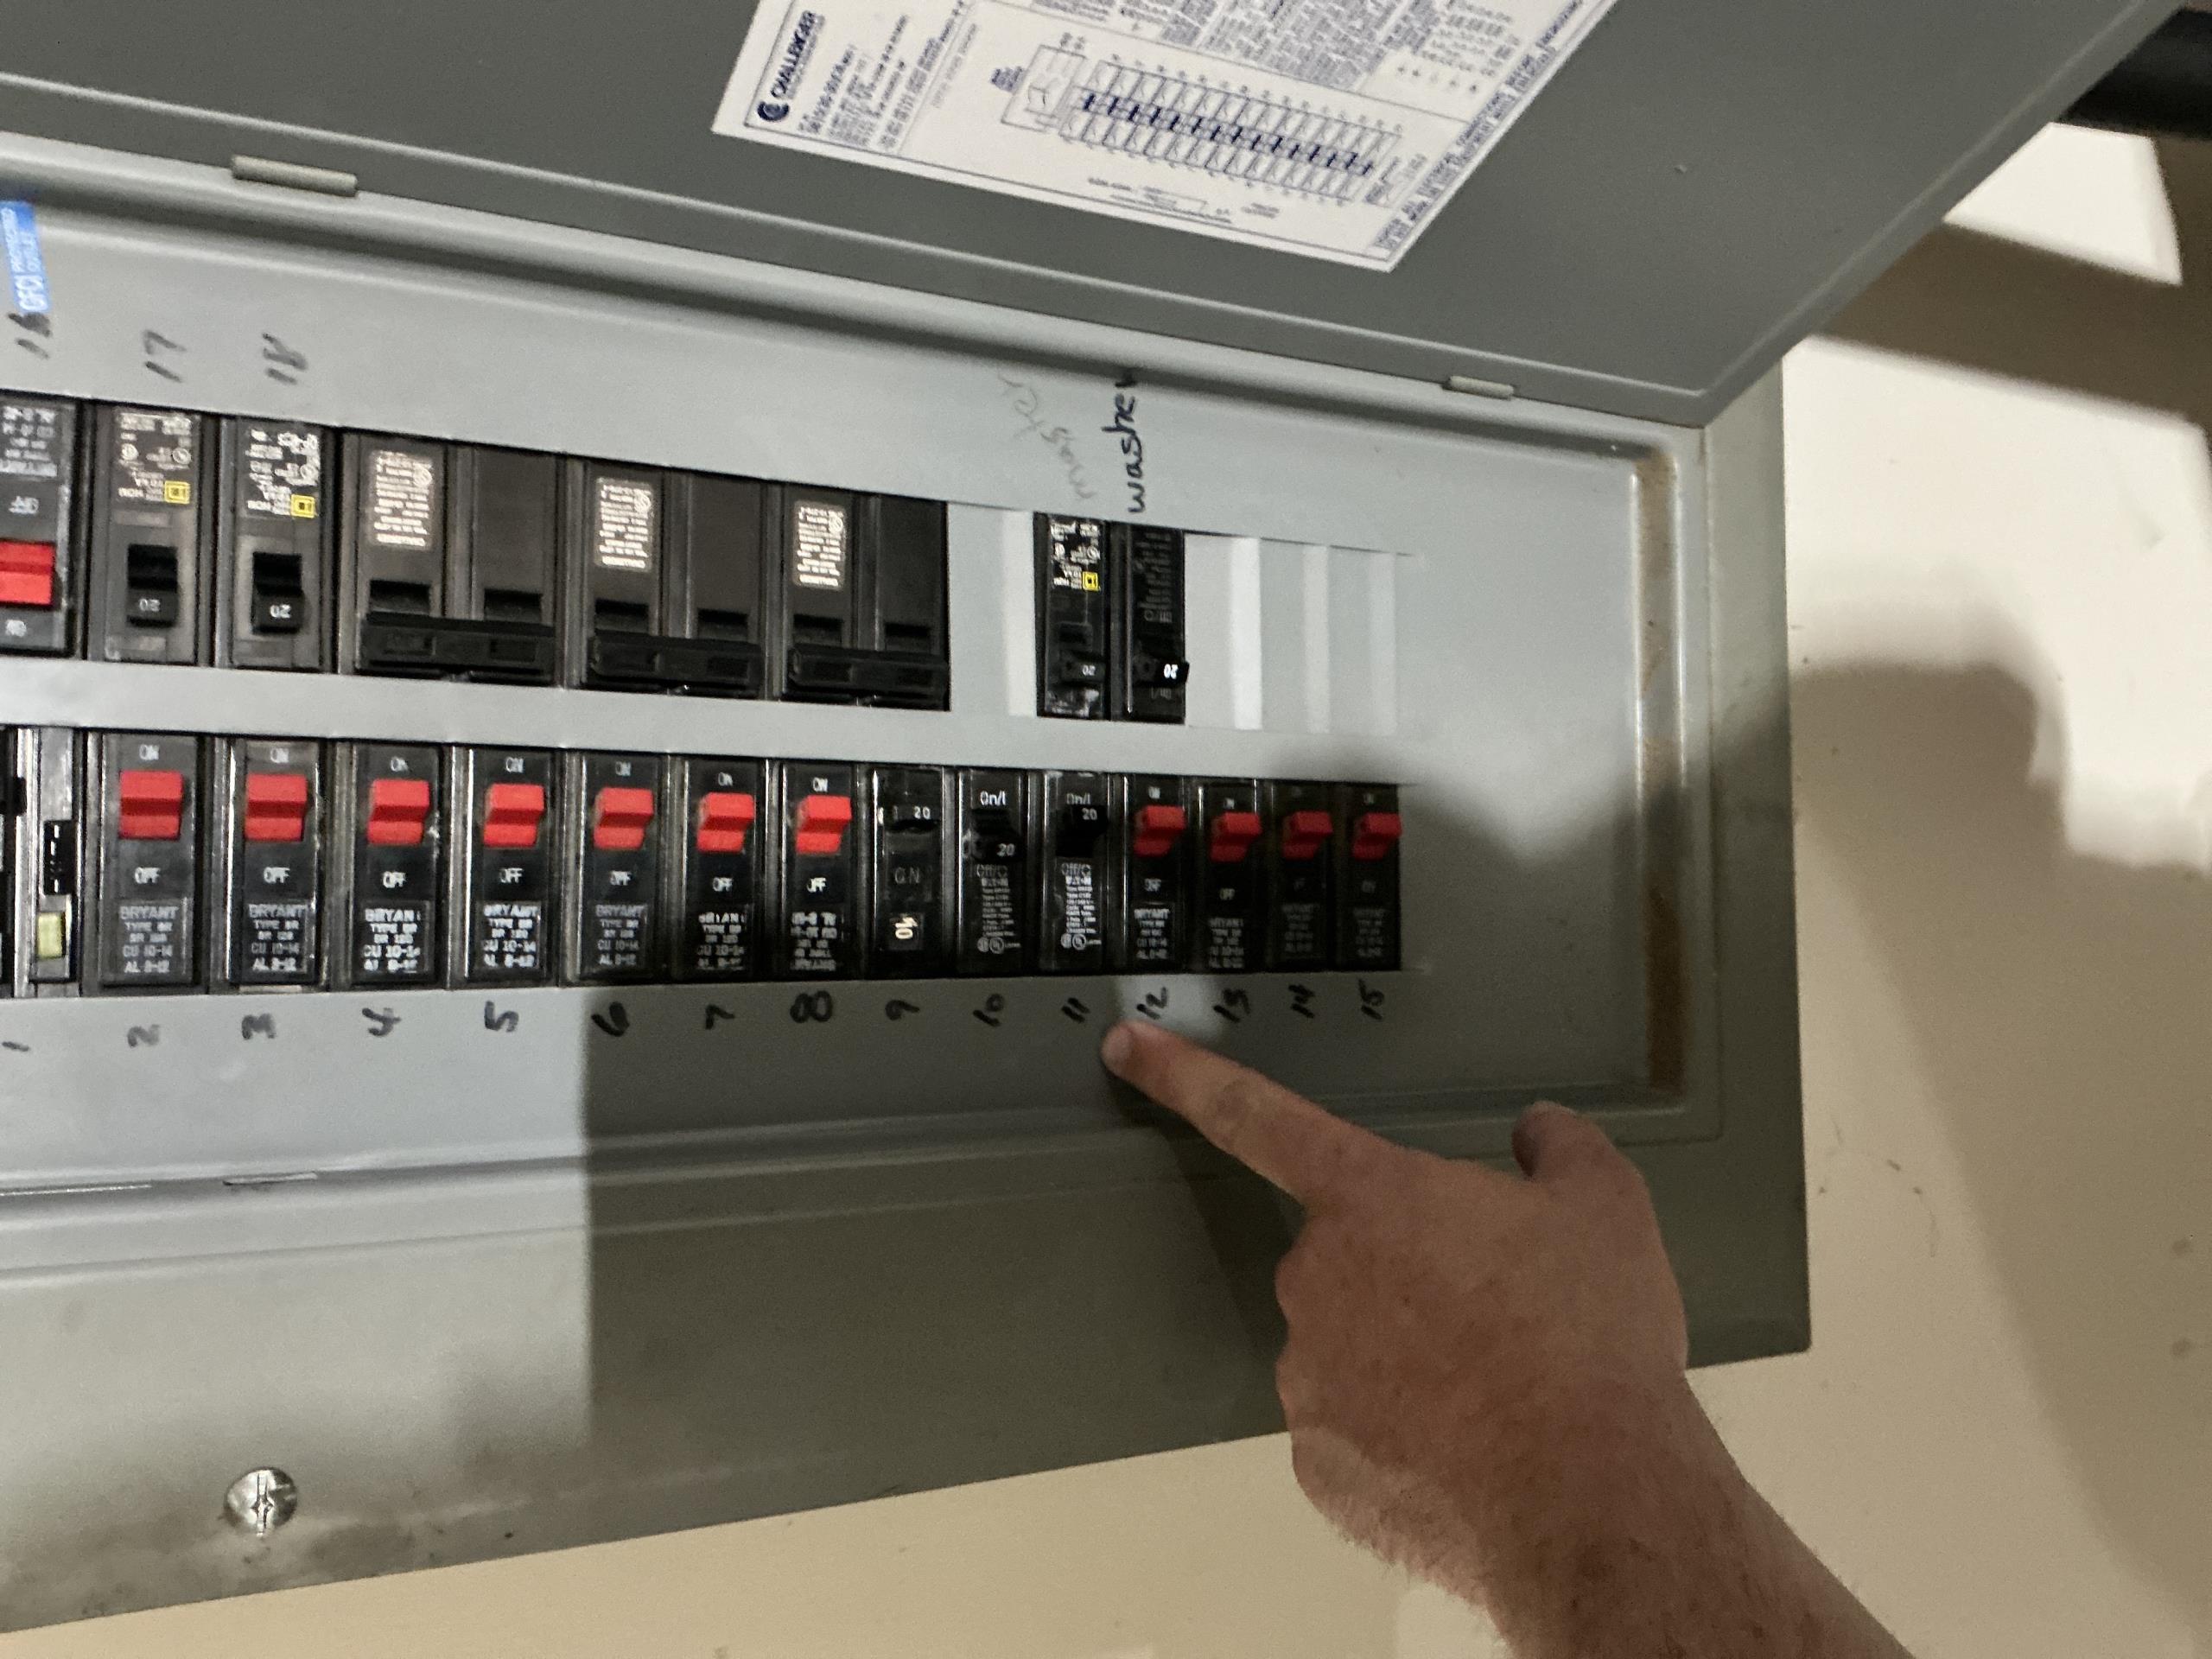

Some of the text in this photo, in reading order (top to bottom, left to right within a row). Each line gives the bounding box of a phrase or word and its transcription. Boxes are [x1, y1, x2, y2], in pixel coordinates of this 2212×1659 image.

[143, 329, 187, 383] 17
[262, 333, 308, 385] 18
[138, 598, 162, 613] 20
[269, 605, 292, 619] 20
[1082, 664, 1096, 677] 20
[1163, 664, 1179, 679] 20
[140, 744, 159, 761] ON
[270, 747, 289, 764] ON
[505, 756, 524, 773] ON
[614, 761, 632, 777] ON
[812, 777, 829, 792] ON
[913, 805, 931, 820] 20
[1082, 808, 1098, 821] 20
[997, 843, 1016, 856] 20
[134, 867, 162, 885] OFF
[264, 867, 290, 885] OFF
[383, 870, 408, 889] OFF
[119, 906, 179, 919] BRYANT
[248, 904, 308, 918] BRYANT
[594, 904, 646, 917] BRYANT
[124, 960, 141, 973] AL
[599, 954, 613, 966] AL
[790, 989, 834, 1024] 8
[1136, 986, 1169, 1020] 12
[1213, 988, 1251, 1023] 13
[1357, 978, 1385, 1020] 15
[484, 1001, 519, 1033] 5
[705, 1004, 735, 1030] 7
[885, 999, 920, 1020] 9
[973, 994, 1005, 1027] 10
[1061, 997, 1091, 1024] 11
[241, 1013, 276, 1040] 3
[361, 1007, 402, 1037] 4
[591, 1001, 630, 1037] 6
[127, 1024, 160, 1047] 2
